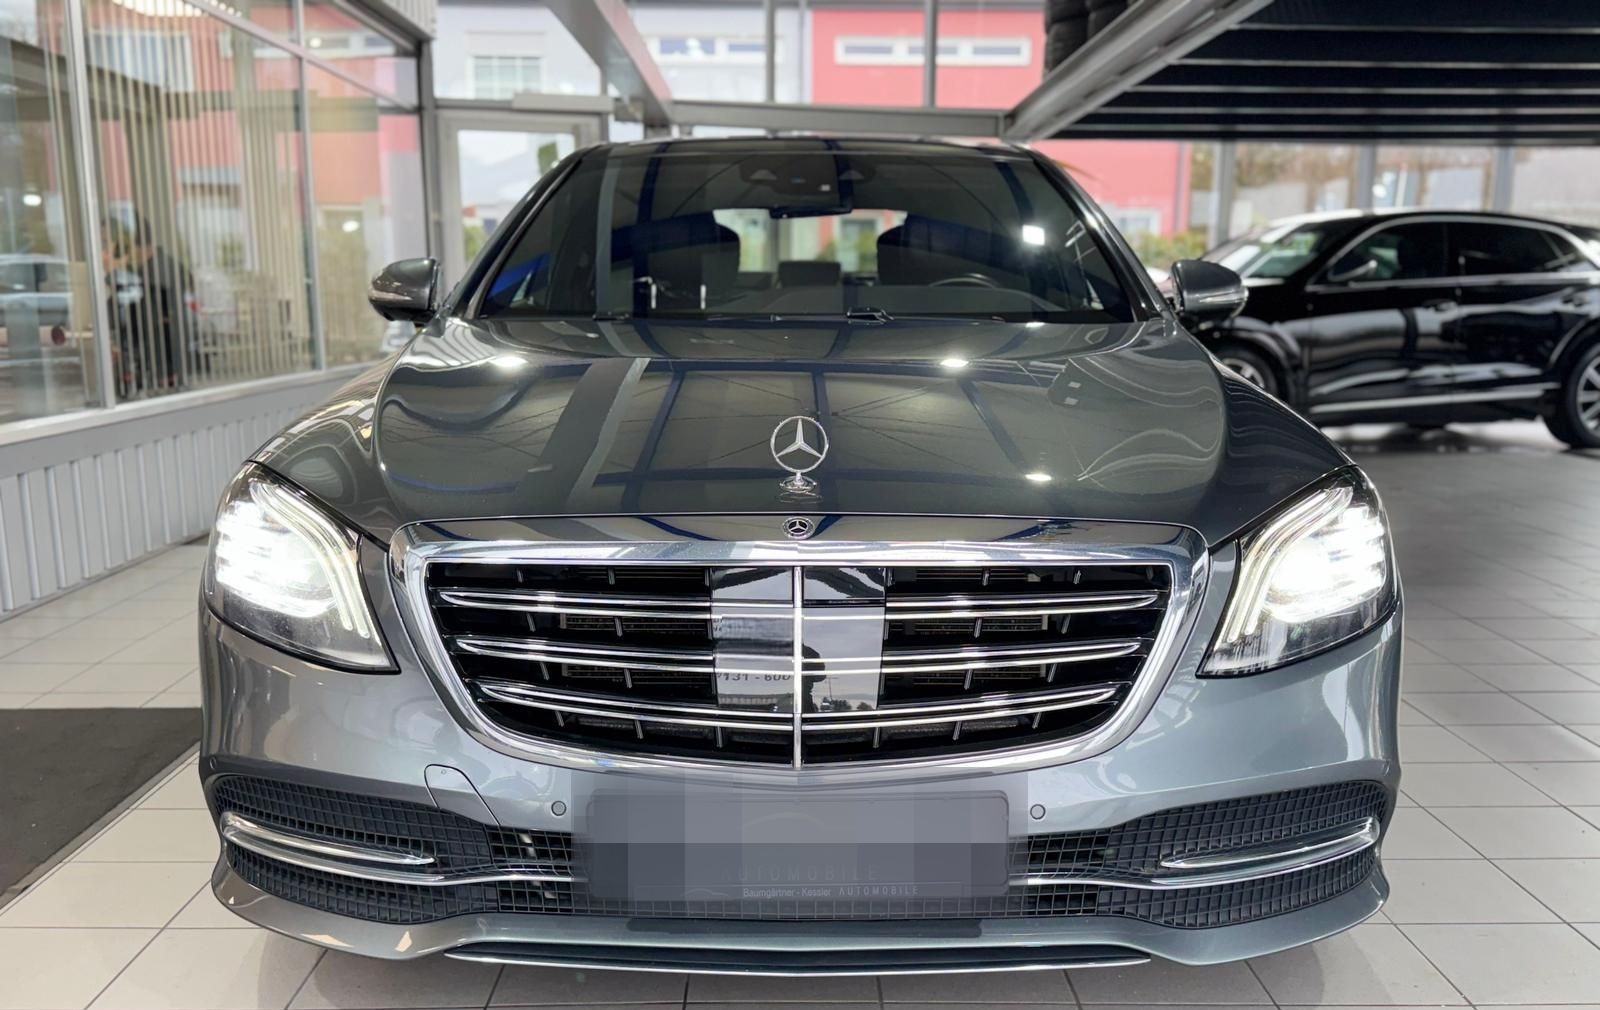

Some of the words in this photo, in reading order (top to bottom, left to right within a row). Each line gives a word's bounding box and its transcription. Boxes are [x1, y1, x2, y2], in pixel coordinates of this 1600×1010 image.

[721, 864, 878, 882] AUTOMOBILE
[742, 887, 795, 898] Baumgärtner
[801, 886, 832, 897] Kessler
[838, 885, 919, 896] AUTOMOBILE
